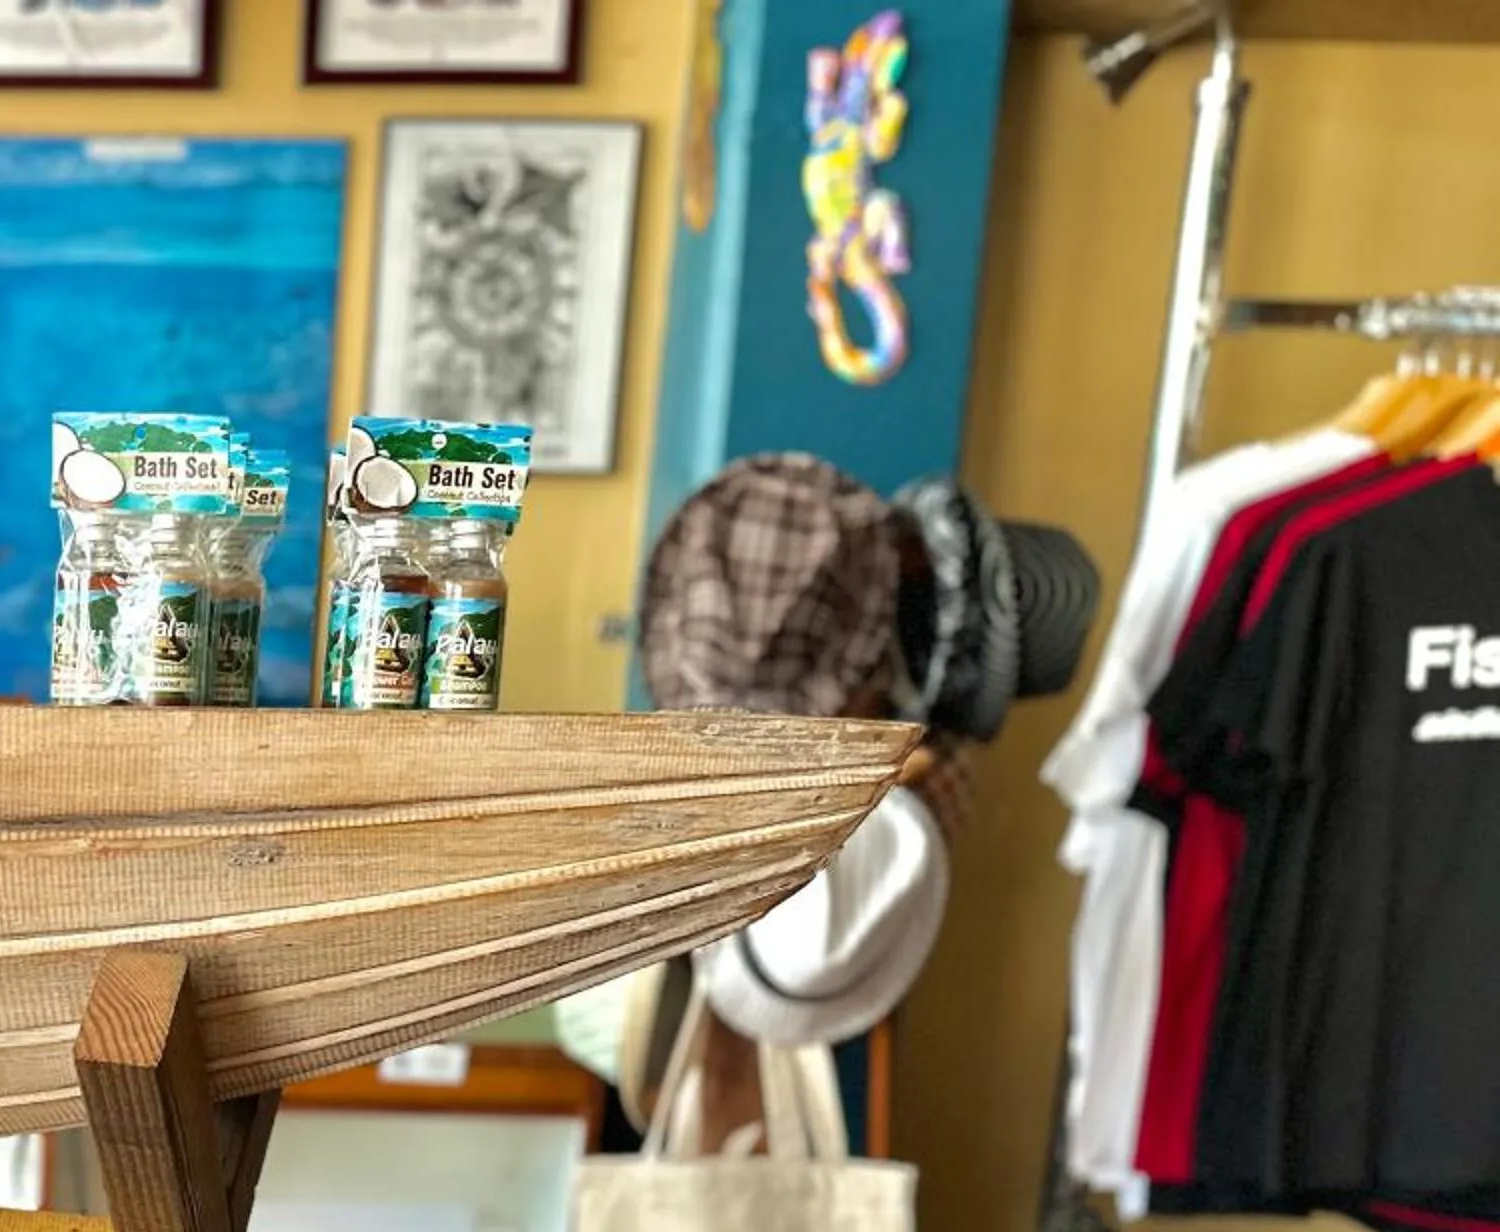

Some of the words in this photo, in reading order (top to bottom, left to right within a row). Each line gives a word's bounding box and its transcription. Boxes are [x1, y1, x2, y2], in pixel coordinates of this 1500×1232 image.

[134, 454, 177, 478] Bath
[185, 456, 218, 478] Set
[428, 463, 473, 488] Bath
[481, 467, 516, 490] Set
[246, 489, 277, 505] Set
[435, 633, 497, 655] Palau
